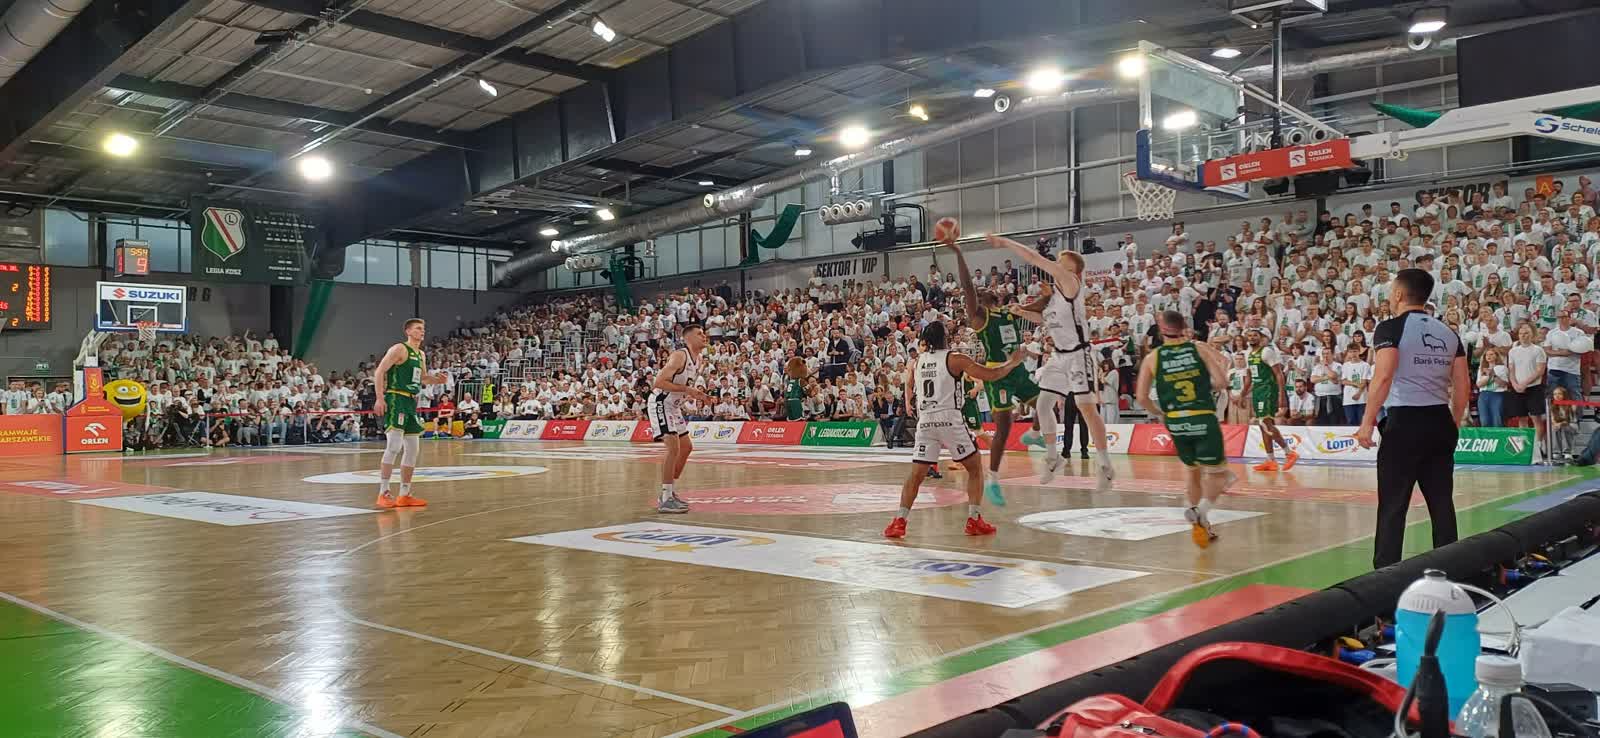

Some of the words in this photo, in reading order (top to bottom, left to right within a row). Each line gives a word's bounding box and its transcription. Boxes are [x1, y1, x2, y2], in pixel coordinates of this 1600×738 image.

[1308, 148, 1332, 157] ORLEN
[1238, 160, 1260, 170] ORLEN
[1539, 182, 1551, 194] A
[137, 258, 148, 273] 9
[816, 260, 851, 278] SEKTOR
[862, 257, 878, 274] VIP
[11, 283, 19, 292] 2
[128, 290, 180, 300] SUZUKI
[11, 318, 19, 327] 2
[1413, 356, 1433, 365] Bank
[1433, 358, 1451, 366] Peka
[923, 379, 935, 398] 0
[1174, 380, 1197, 402] 3
[1326, 438, 1354, 450] LOTTO
[1455, 438, 1499, 453] SZ.COM
[622, 534, 738, 546] LOTTO
